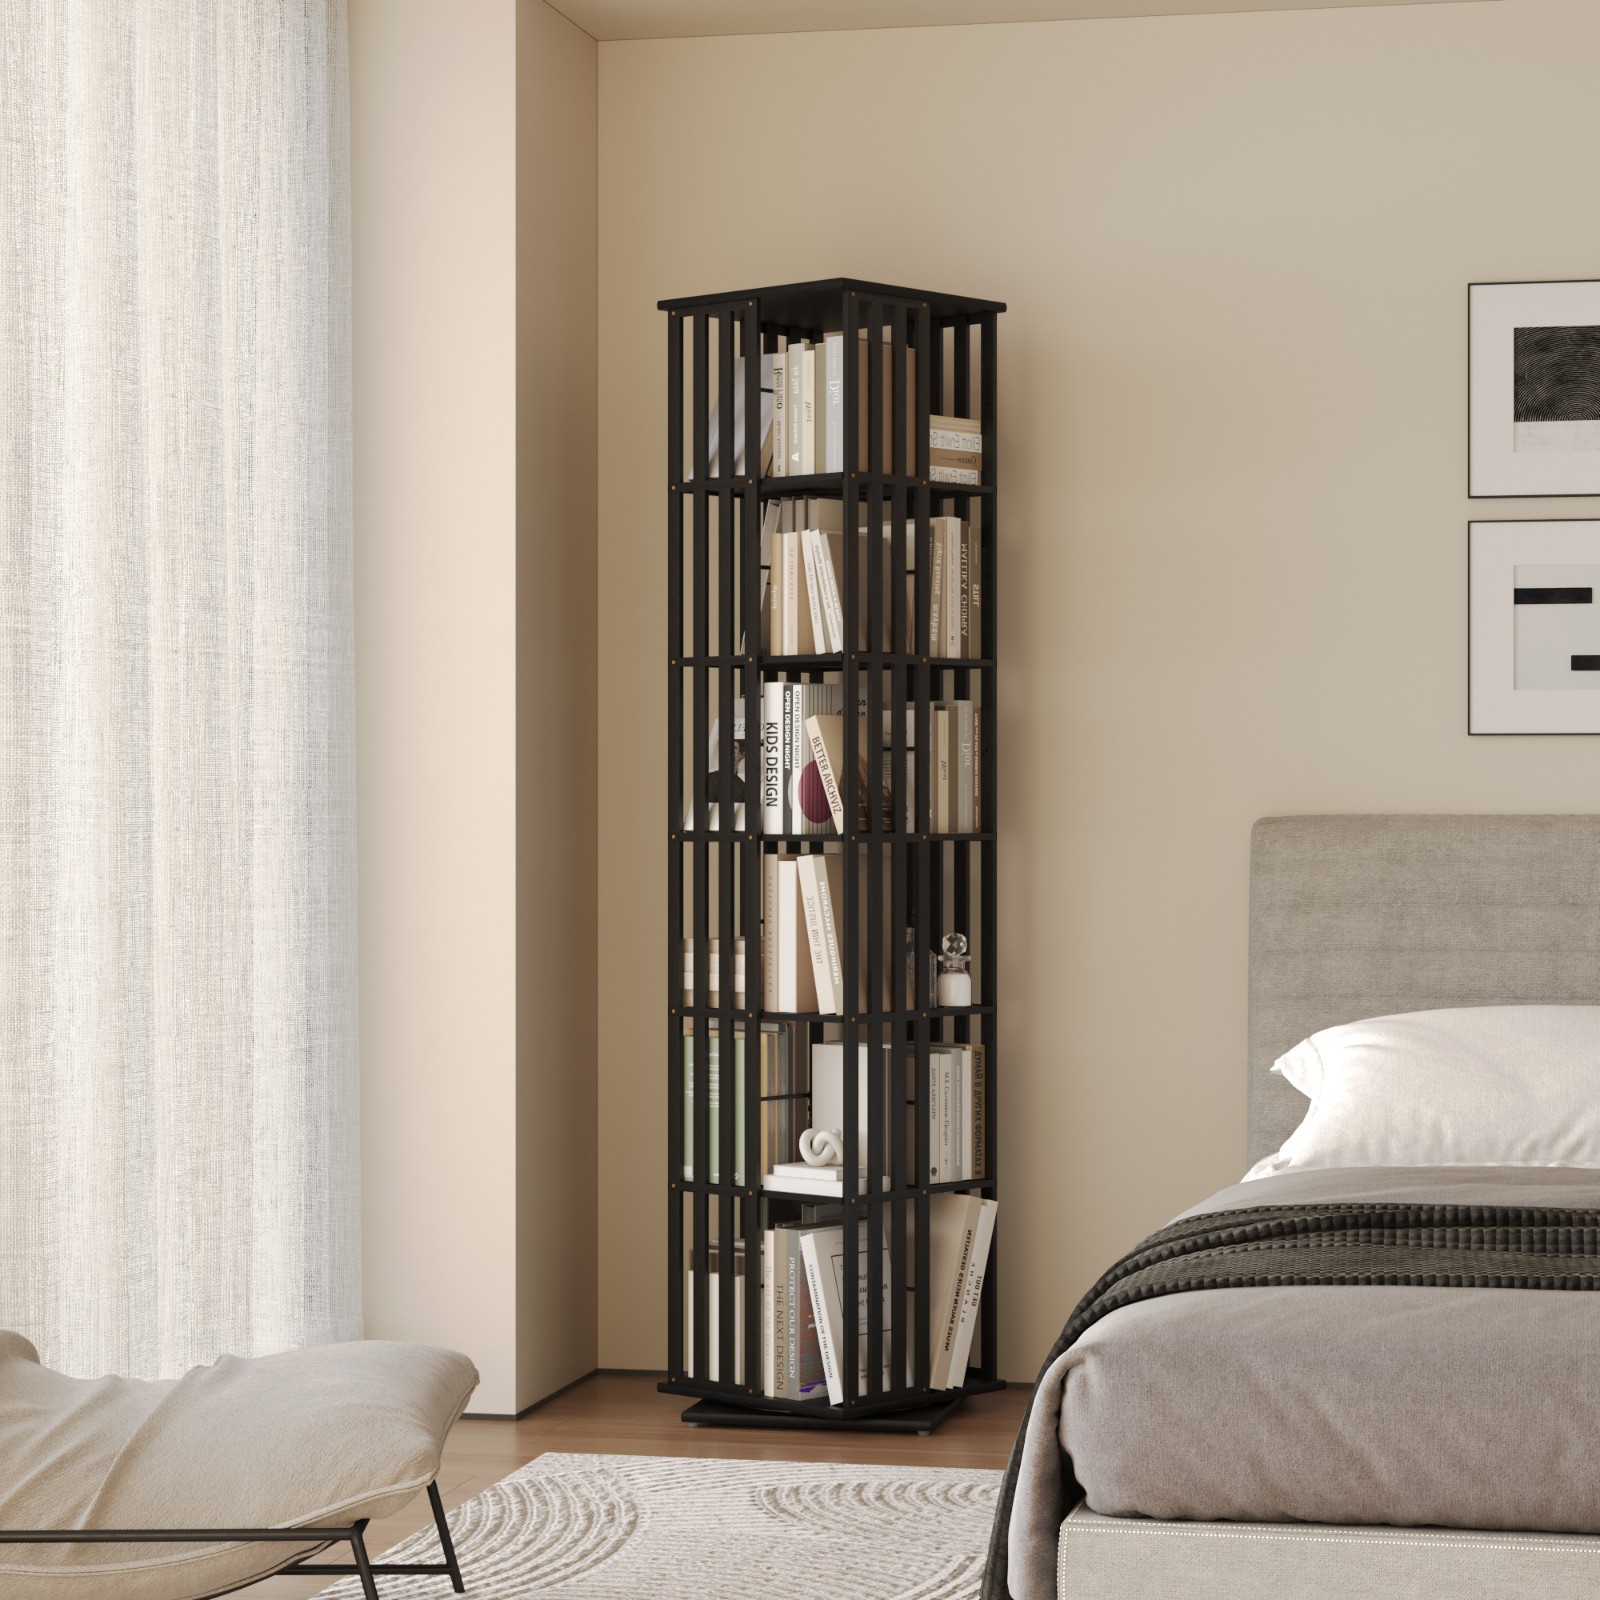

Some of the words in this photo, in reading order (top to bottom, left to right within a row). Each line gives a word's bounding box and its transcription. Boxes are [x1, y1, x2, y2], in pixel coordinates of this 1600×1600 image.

[766, 722, 778, 754] KIDS
[766, 756, 778, 807] DESIGN
[812, 736, 829, 772] BETTER
[822, 774, 842, 815] ARCHVIZ
[974, 1050, 982, 1079] ДУМАЙ
[974, 1090, 982, 1122] ДРУГИХ
[974, 1124, 982, 1168] ФОРМАТАХ
[776, 1283, 784, 1306] THE
[788, 1257, 796, 1308] PROTECT
[776, 1310, 784, 1342] NEXT
[788, 1310, 796, 1336] OUR
[808, 1264, 824, 1324] CONTAMINATION
[820, 1326, 826, 1334] OF
[824, 1351, 834, 1378] DESIGN
[776, 1345, 784, 1391] DESIGN
[788, 1337, 796, 1379] DESIGN
